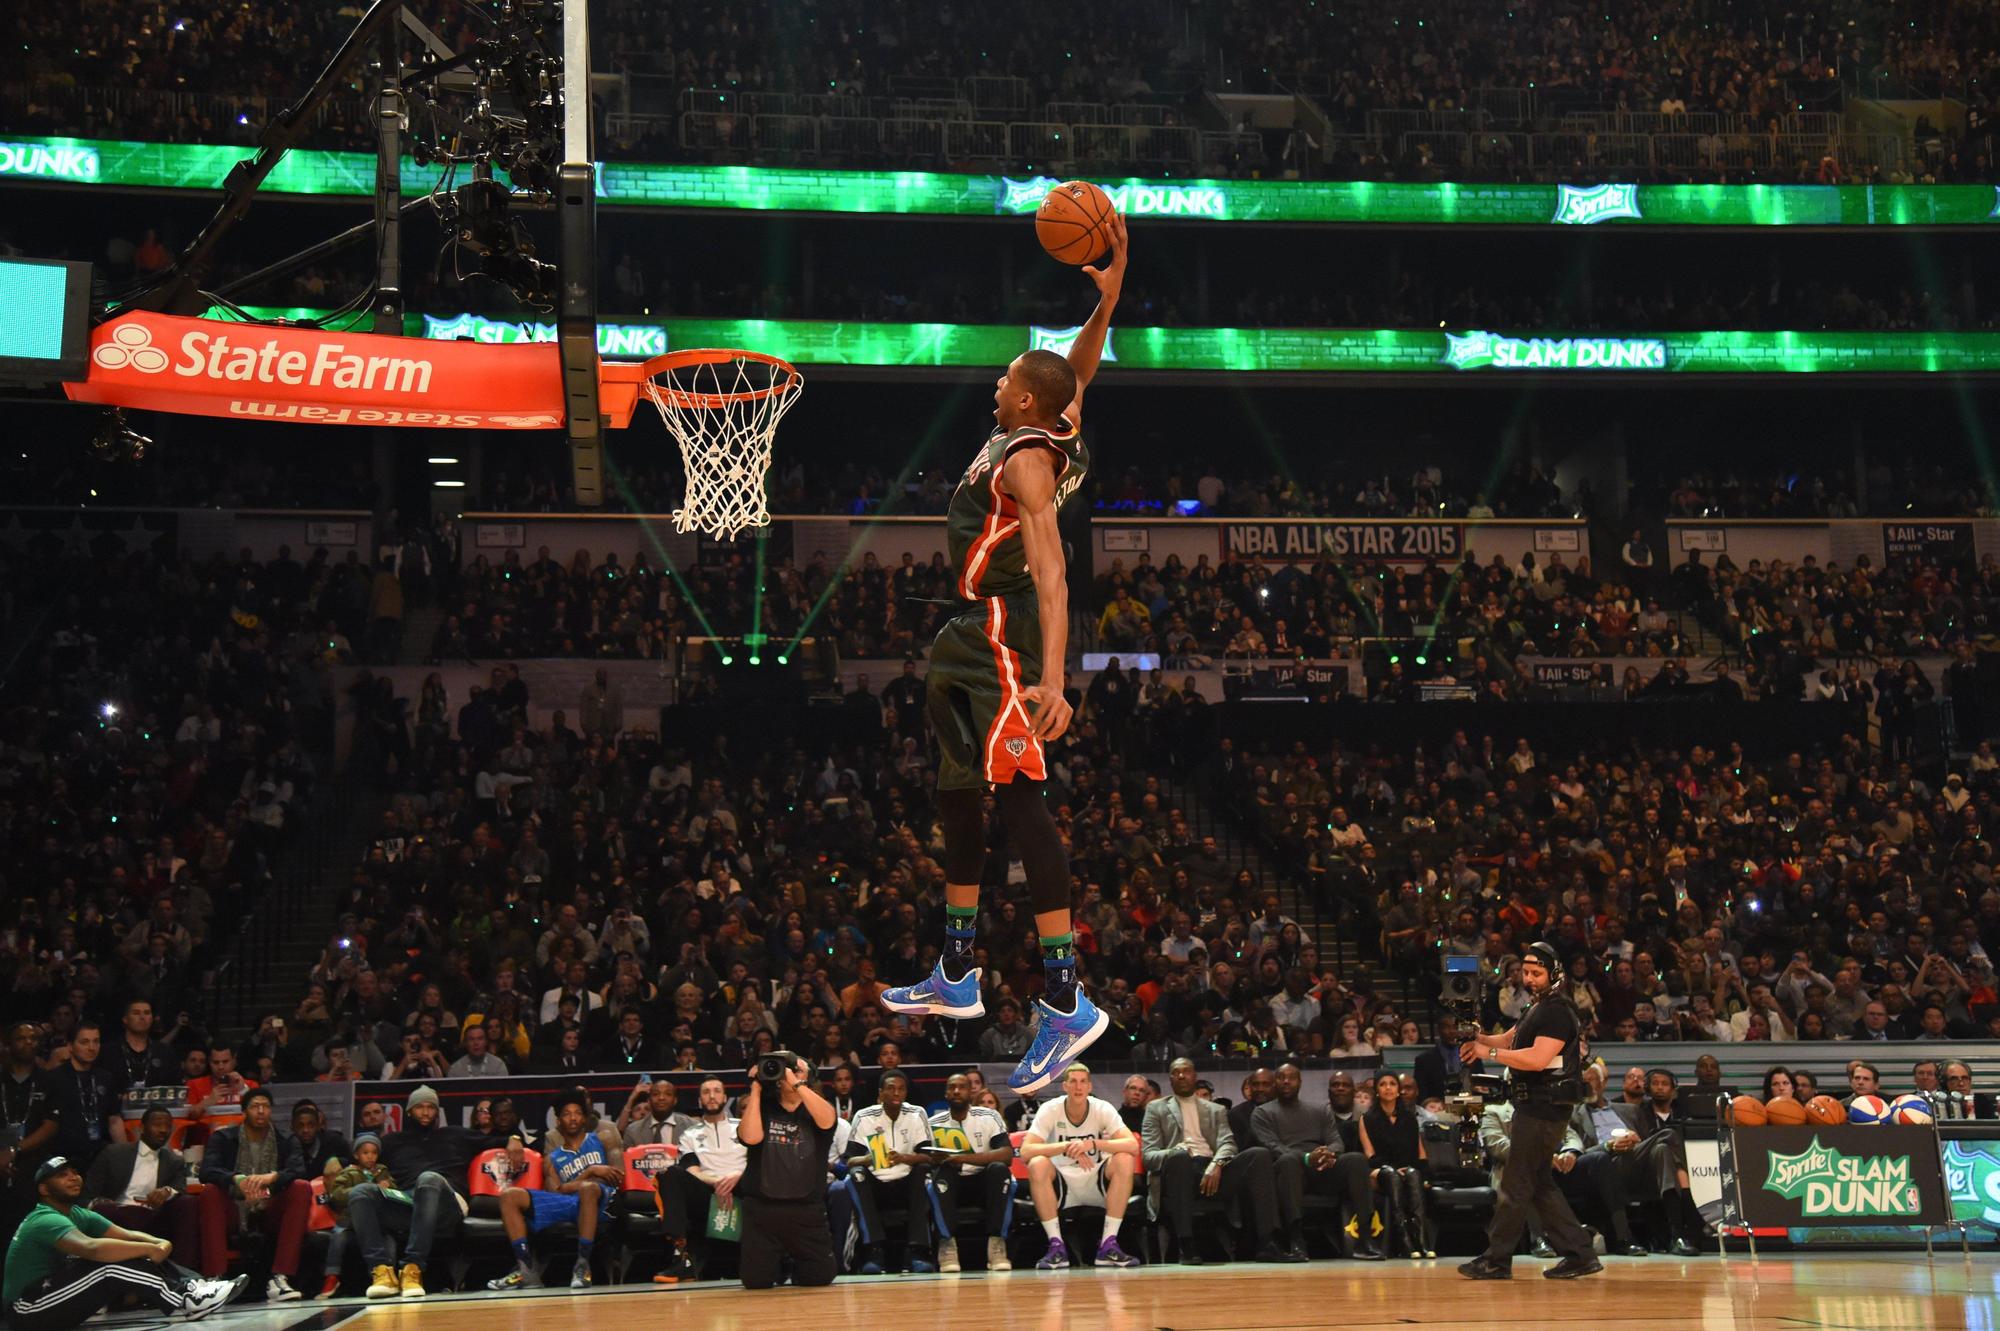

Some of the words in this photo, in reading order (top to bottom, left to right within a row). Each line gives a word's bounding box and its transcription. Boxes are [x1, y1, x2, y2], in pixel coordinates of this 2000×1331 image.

[1134, 189, 1218, 215] DUNK
[1566, 185, 1625, 222] Sprite
[597, 328, 656, 354] UNK
[175, 331, 307, 386] State
[309, 344, 432, 393] Farm
[1493, 343, 1568, 366] SLAM
[1576, 343, 1655, 367] DUNK
[1229, 526, 1279, 554] NBA
[1402, 526, 1456, 554] 2015
[1897, 527, 1916, 541] All
[1926, 526, 1956, 541] Star
[1307, 669, 1333, 682] Star
[1546, 667, 1562, 681] All
[1775, 1148, 1827, 1184] Sprite
[1837, 1157, 1907, 1181] SLAM
[1806, 1182, 1905, 1213] DUNK
